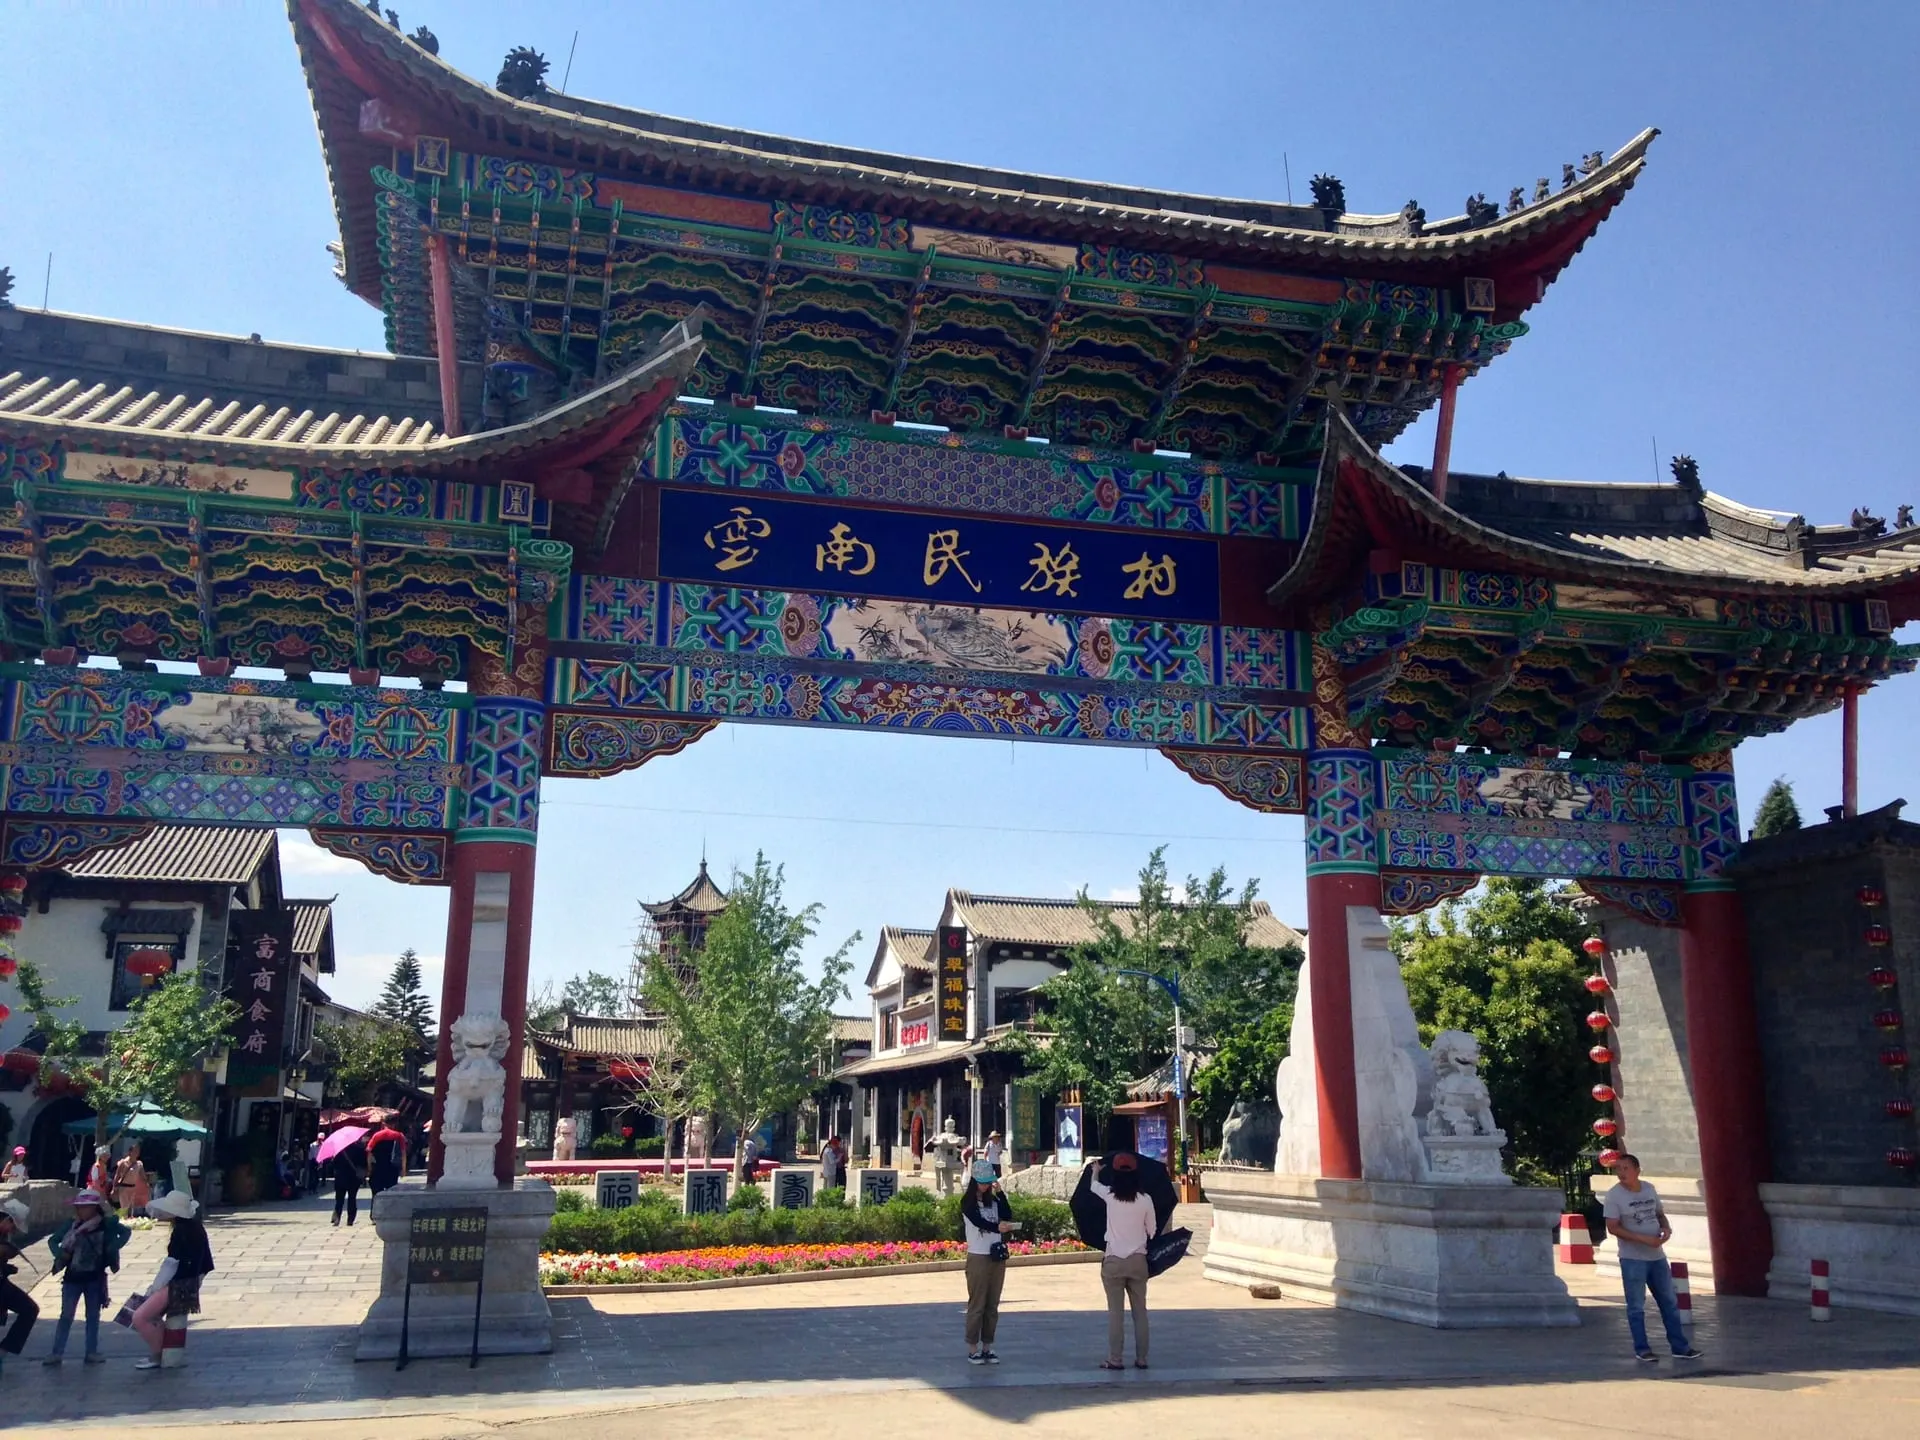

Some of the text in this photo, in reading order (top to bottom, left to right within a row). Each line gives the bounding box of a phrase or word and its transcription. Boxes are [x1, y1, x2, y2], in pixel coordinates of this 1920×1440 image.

[241, 933, 279, 1054] 富商食府
[943, 957, 964, 1031] 翠福珠宝
[602, 1173, 632, 1209] 福
